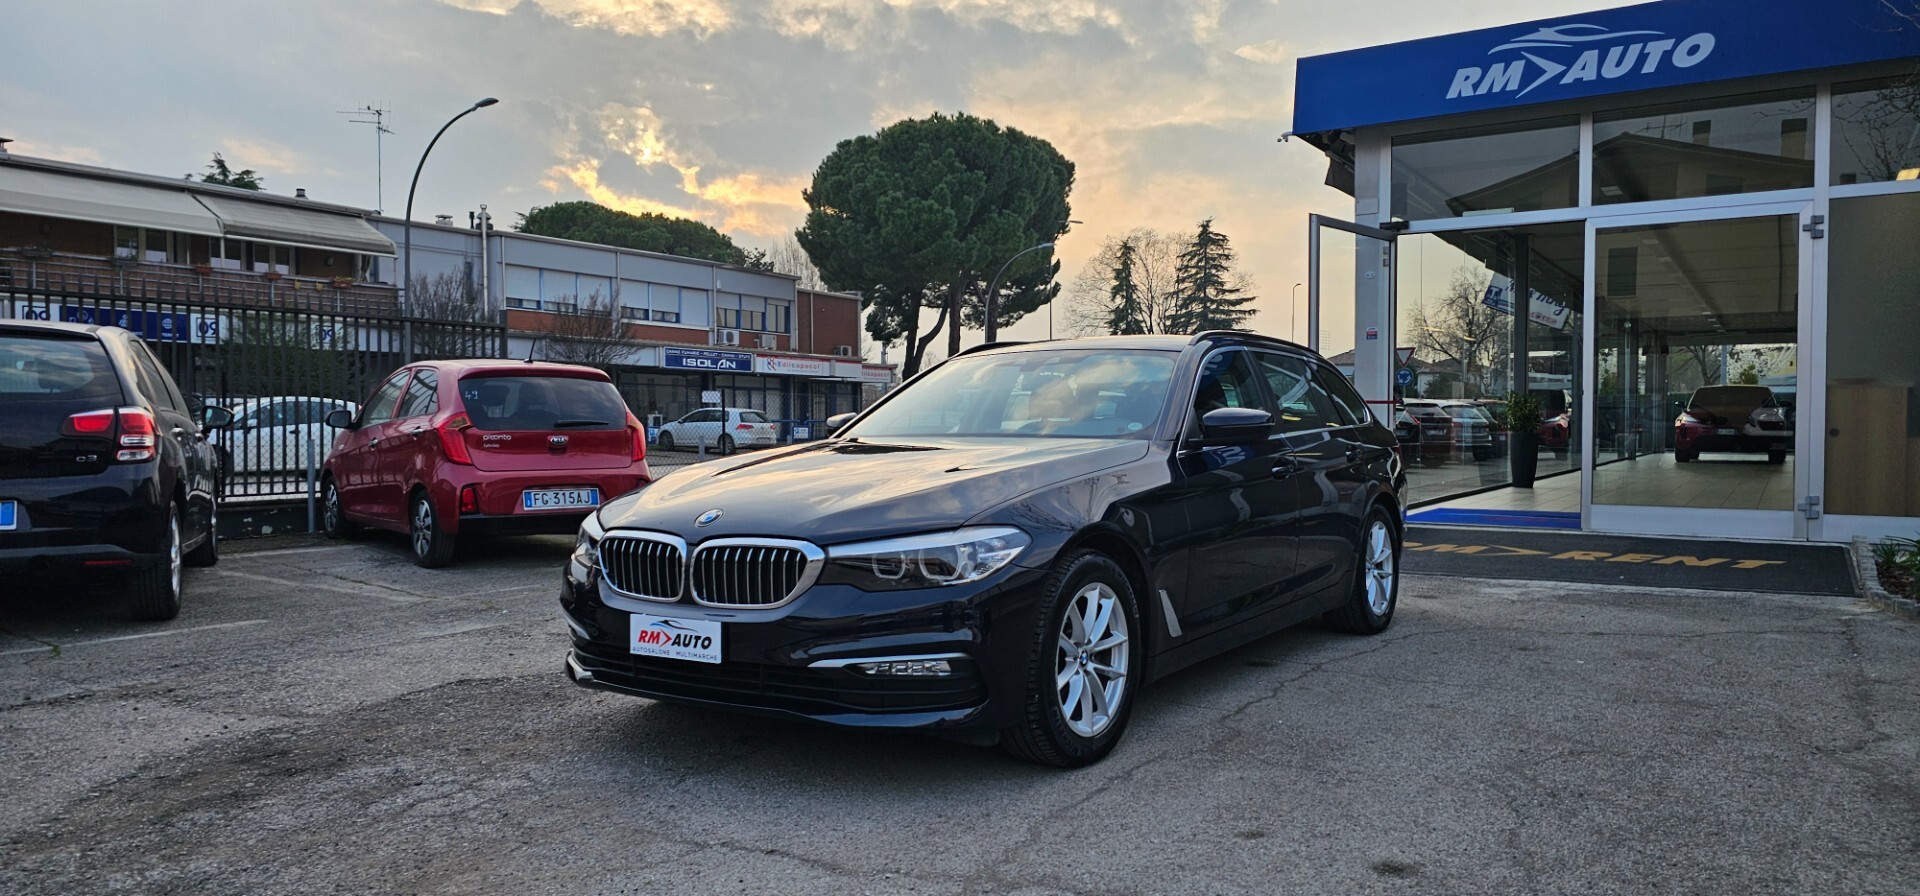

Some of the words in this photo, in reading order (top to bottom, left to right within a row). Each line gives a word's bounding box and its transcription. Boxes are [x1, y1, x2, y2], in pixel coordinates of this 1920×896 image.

[1559, 32, 1716, 85] AUTO
[682, 358, 737, 370] ISOLAN
[777, 361, 820, 370] Edilcapacci
[1549, 550, 1788, 570] RENT
[671, 633, 712, 650] AUTO
[632, 646, 671, 656] AUTOSALONE
[675, 650, 719, 661] MULTIMARCHE
